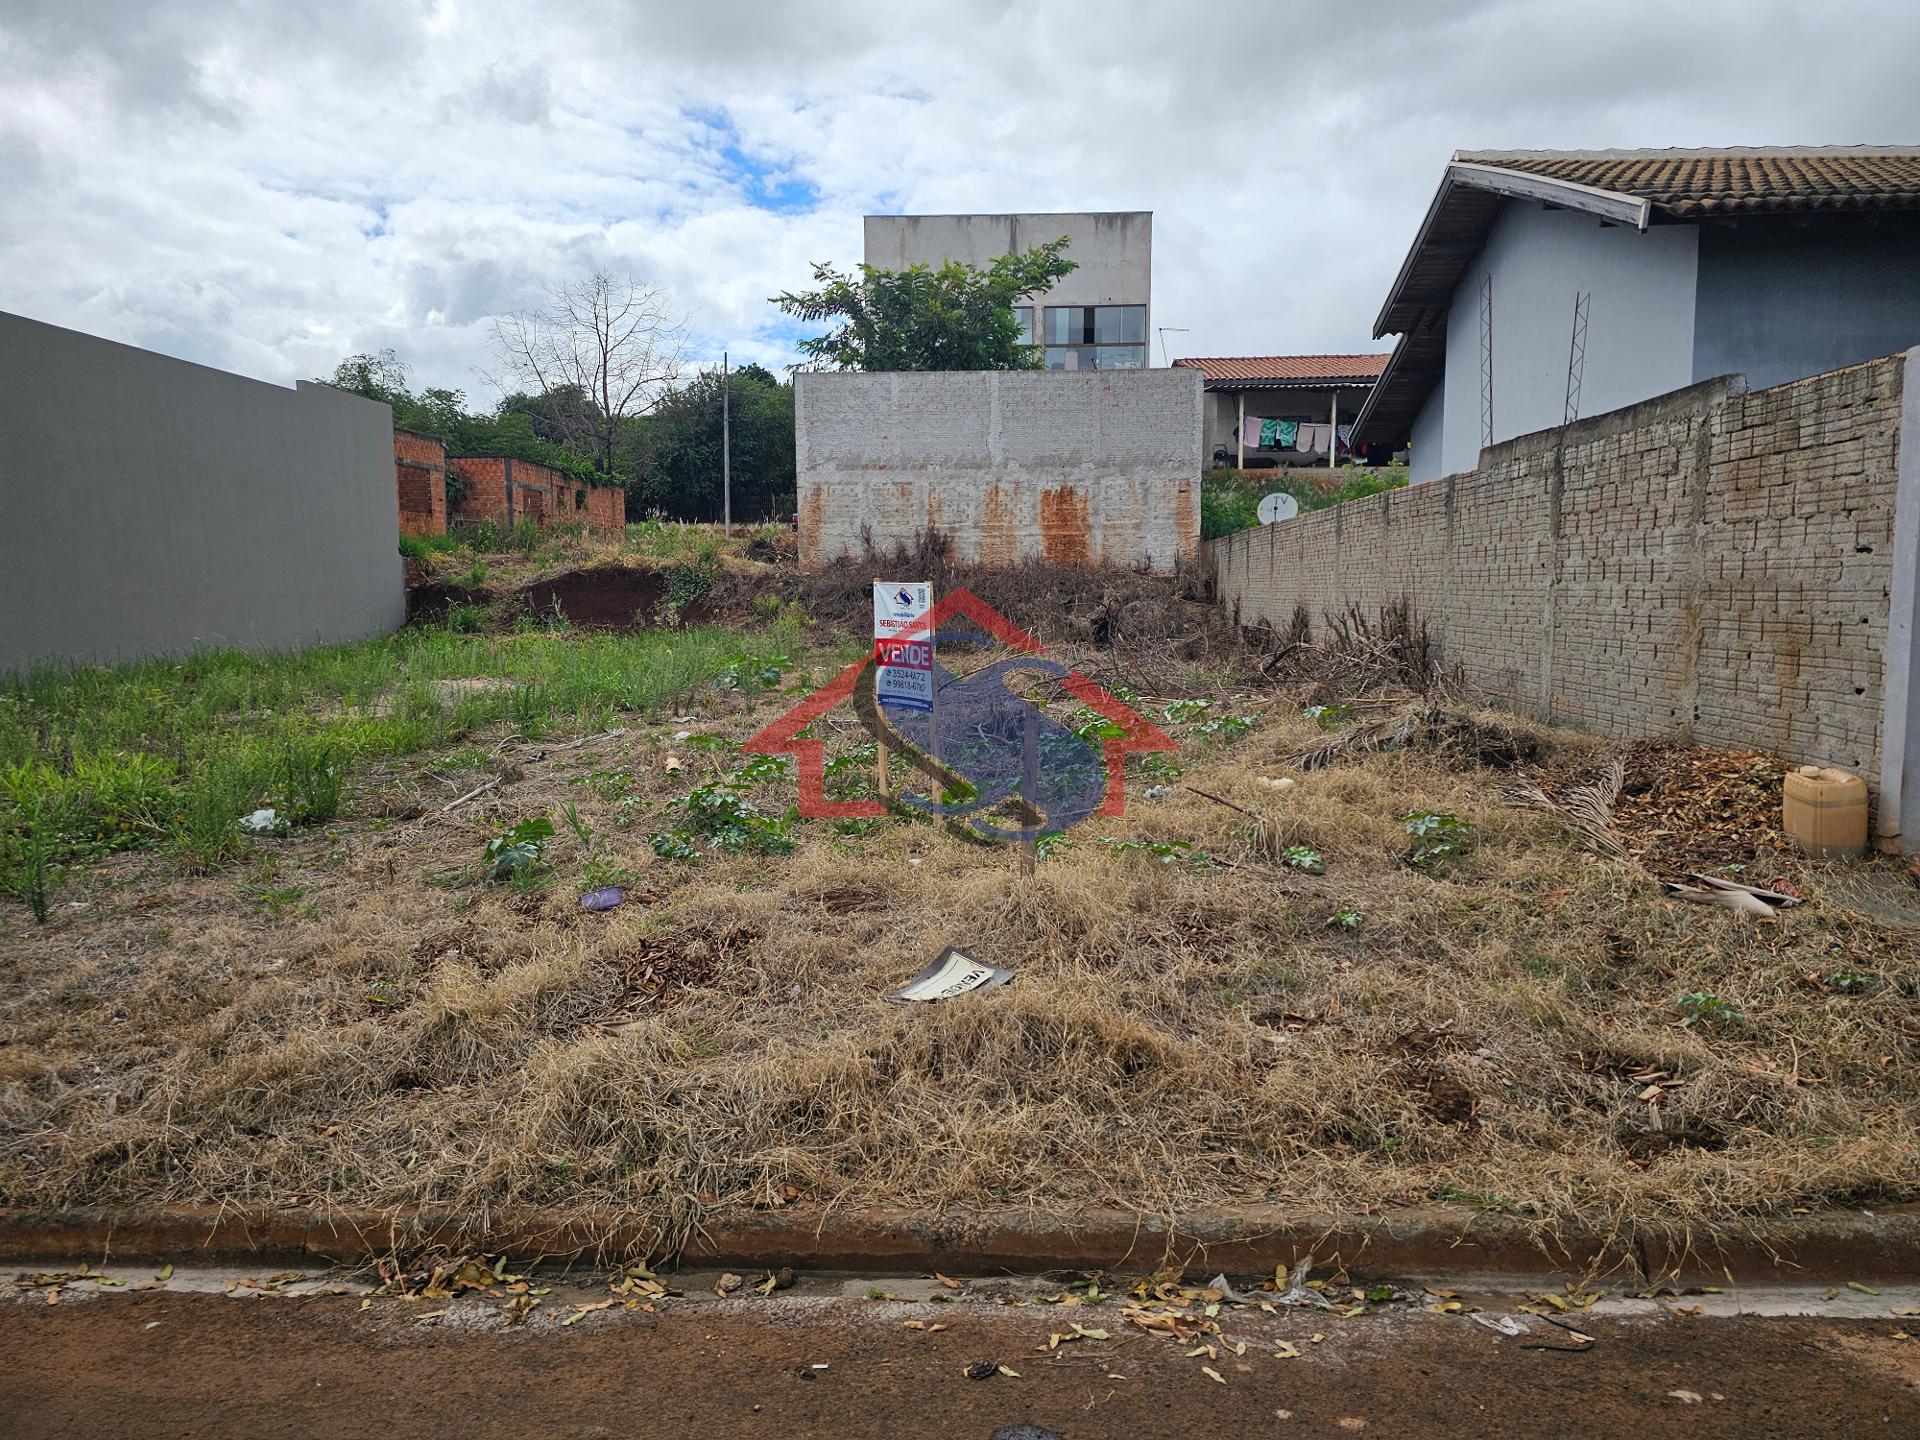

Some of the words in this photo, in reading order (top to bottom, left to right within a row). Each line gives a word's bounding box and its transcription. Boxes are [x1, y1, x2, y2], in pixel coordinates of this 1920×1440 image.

[1272, 495, 1288, 505] TV
[908, 620, 927, 630] SANTOS
[878, 642, 929, 666] VENDE
[941, 970, 985, 995] VENDE
